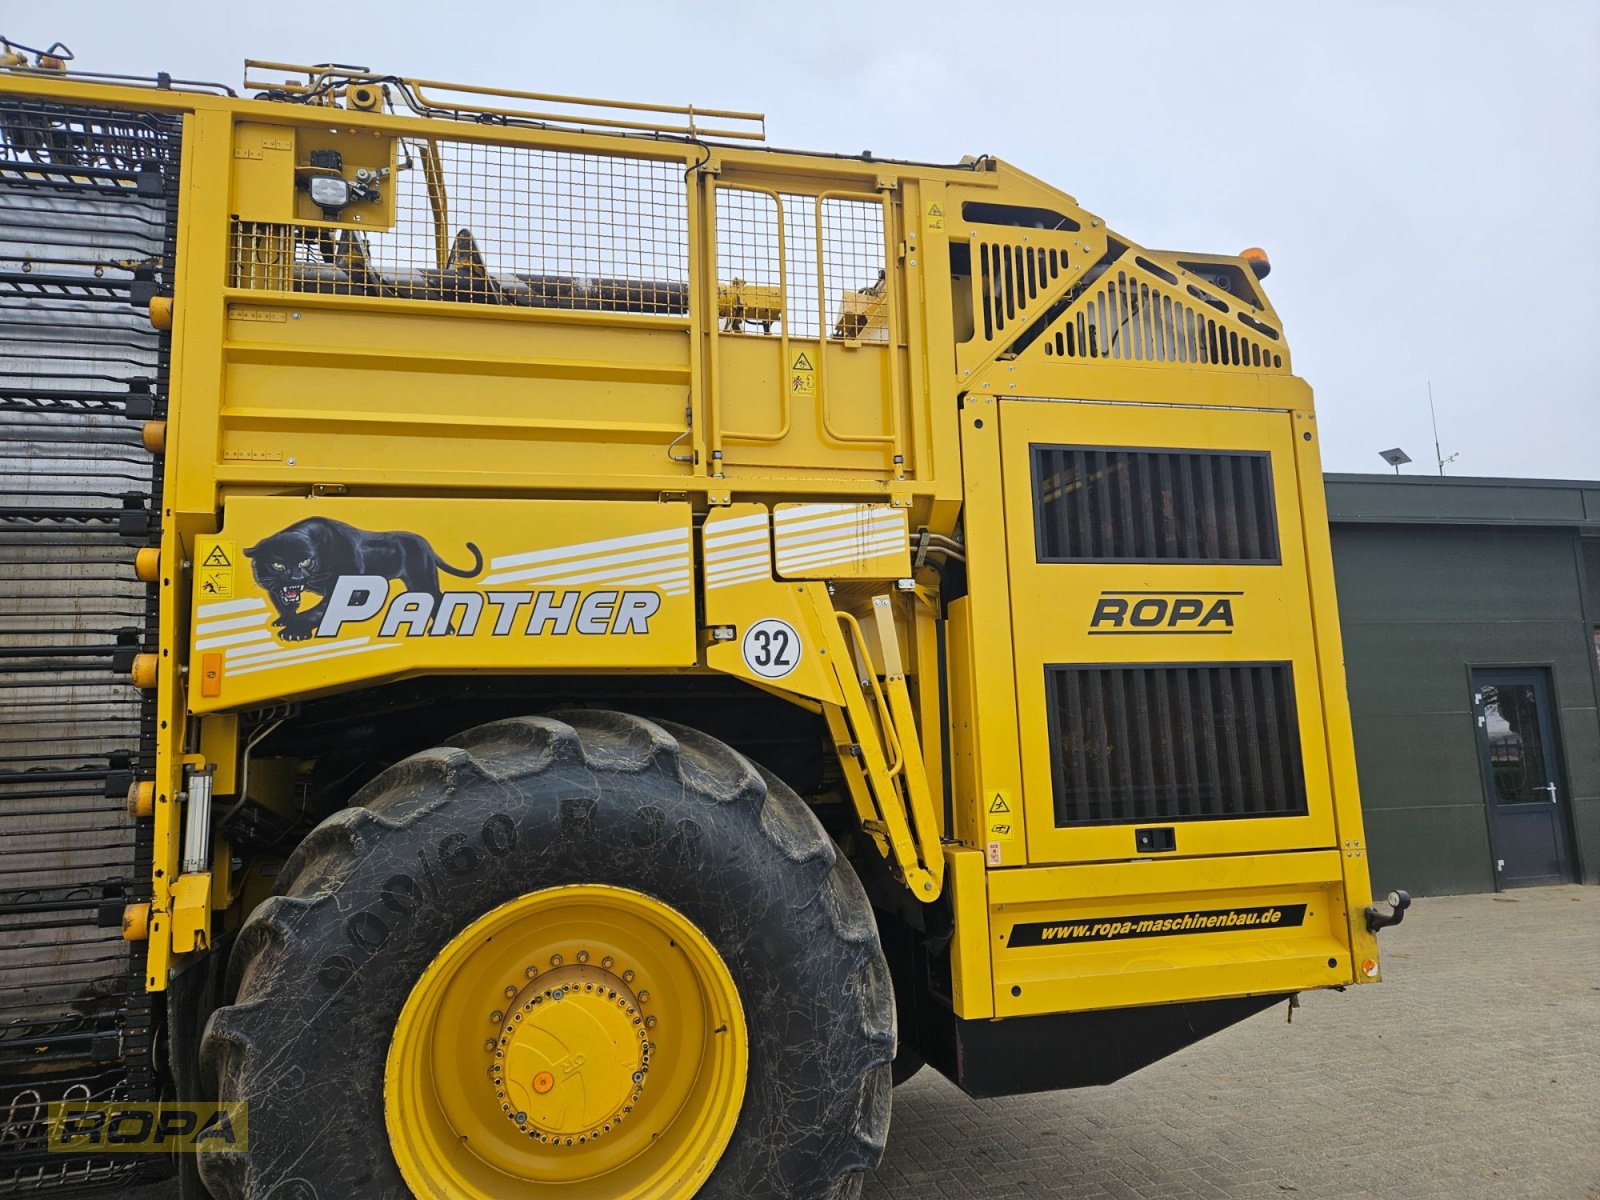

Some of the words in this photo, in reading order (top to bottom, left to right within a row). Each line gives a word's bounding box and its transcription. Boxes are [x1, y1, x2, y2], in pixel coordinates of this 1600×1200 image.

[1090, 599, 1234, 627] ROPA
[754, 630, 790, 666] 32
[1041, 908, 1282, 940] www.ropa-maschinenbau.de
